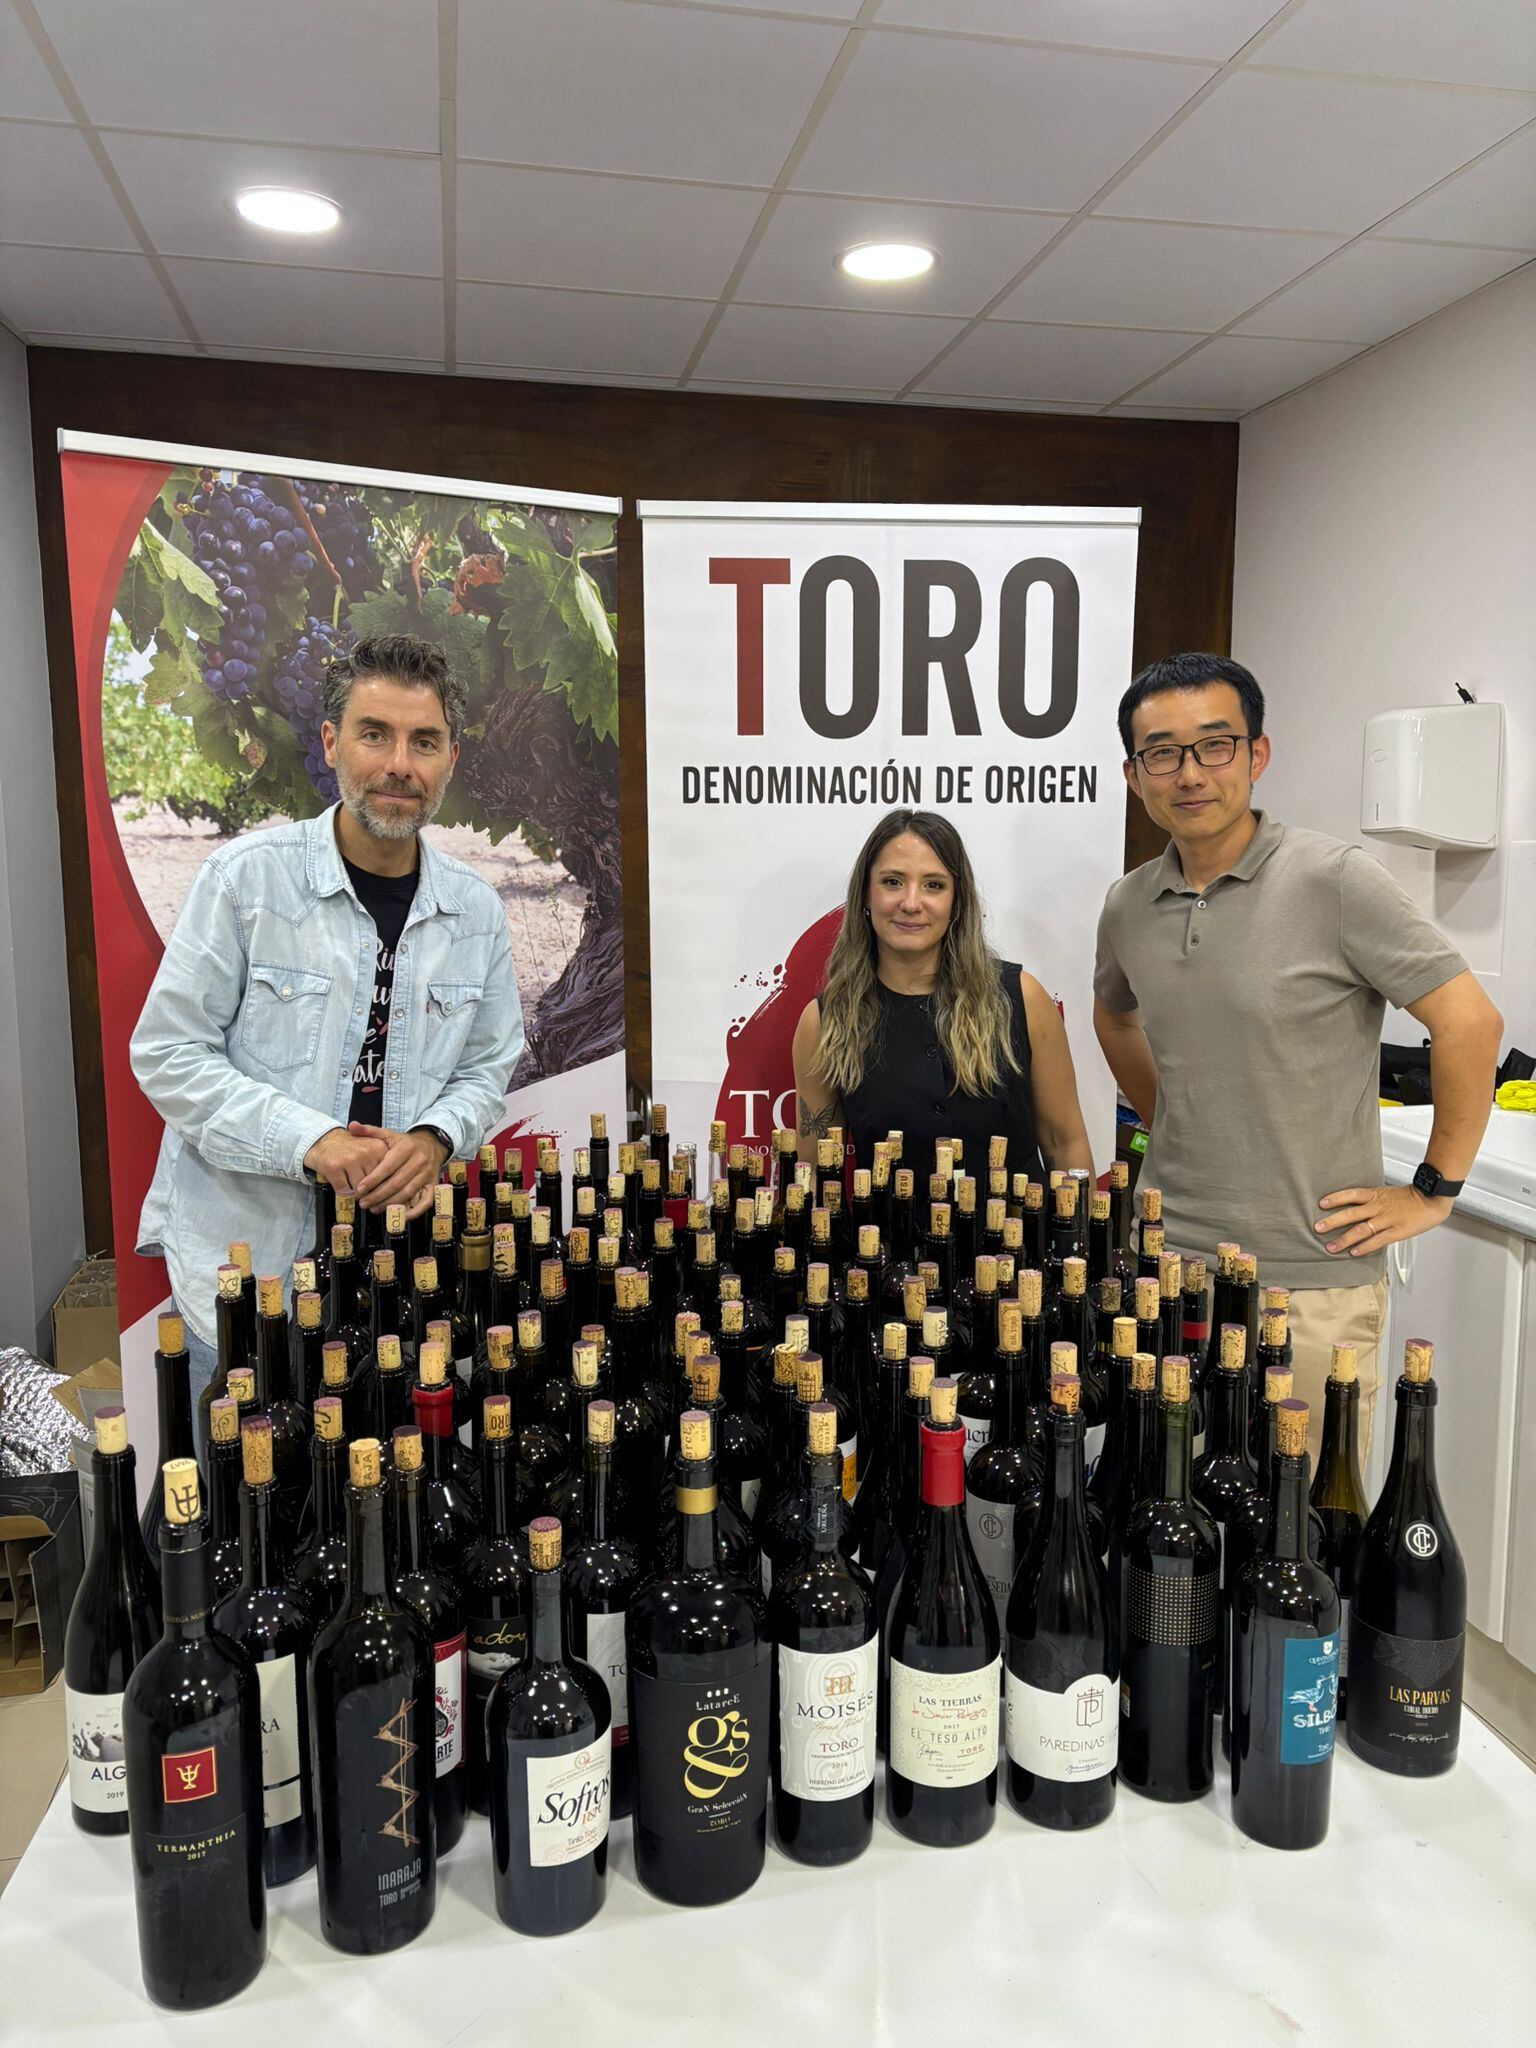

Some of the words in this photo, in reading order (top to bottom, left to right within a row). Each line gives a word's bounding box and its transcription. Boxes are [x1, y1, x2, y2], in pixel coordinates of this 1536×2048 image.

[709, 555, 1081, 740] TORO
[682, 759, 922, 805] DENOMINACIÓN
[935, 766, 972, 805] DE
[985, 764, 1098, 805] ORIGEN
[919, 1696, 937, 1707] LAS
[940, 1694, 982, 1707] TIERRAS
[1389, 1685, 1411, 1704] LAS
[1412, 1688, 1452, 1706] PARVAS
[796, 1690, 874, 1720] MOISÉS
[911, 1727, 921, 1740] EL
[931, 1732, 958, 1744] TESO
[965, 1725, 988, 1742] ALTO
[820, 1737, 859, 1753] TORO
[960, 1744, 984, 1755] TORO
[1039, 1735, 1105, 1753] PAREDINAS
[91, 1765, 126, 1781] ALG
[106, 1791, 125, 1799] 2019
[156, 1829, 237, 1853] TERMANTHIA
[378, 1857, 422, 1891] INARAJA
[379, 1891, 398, 1906] TORO
